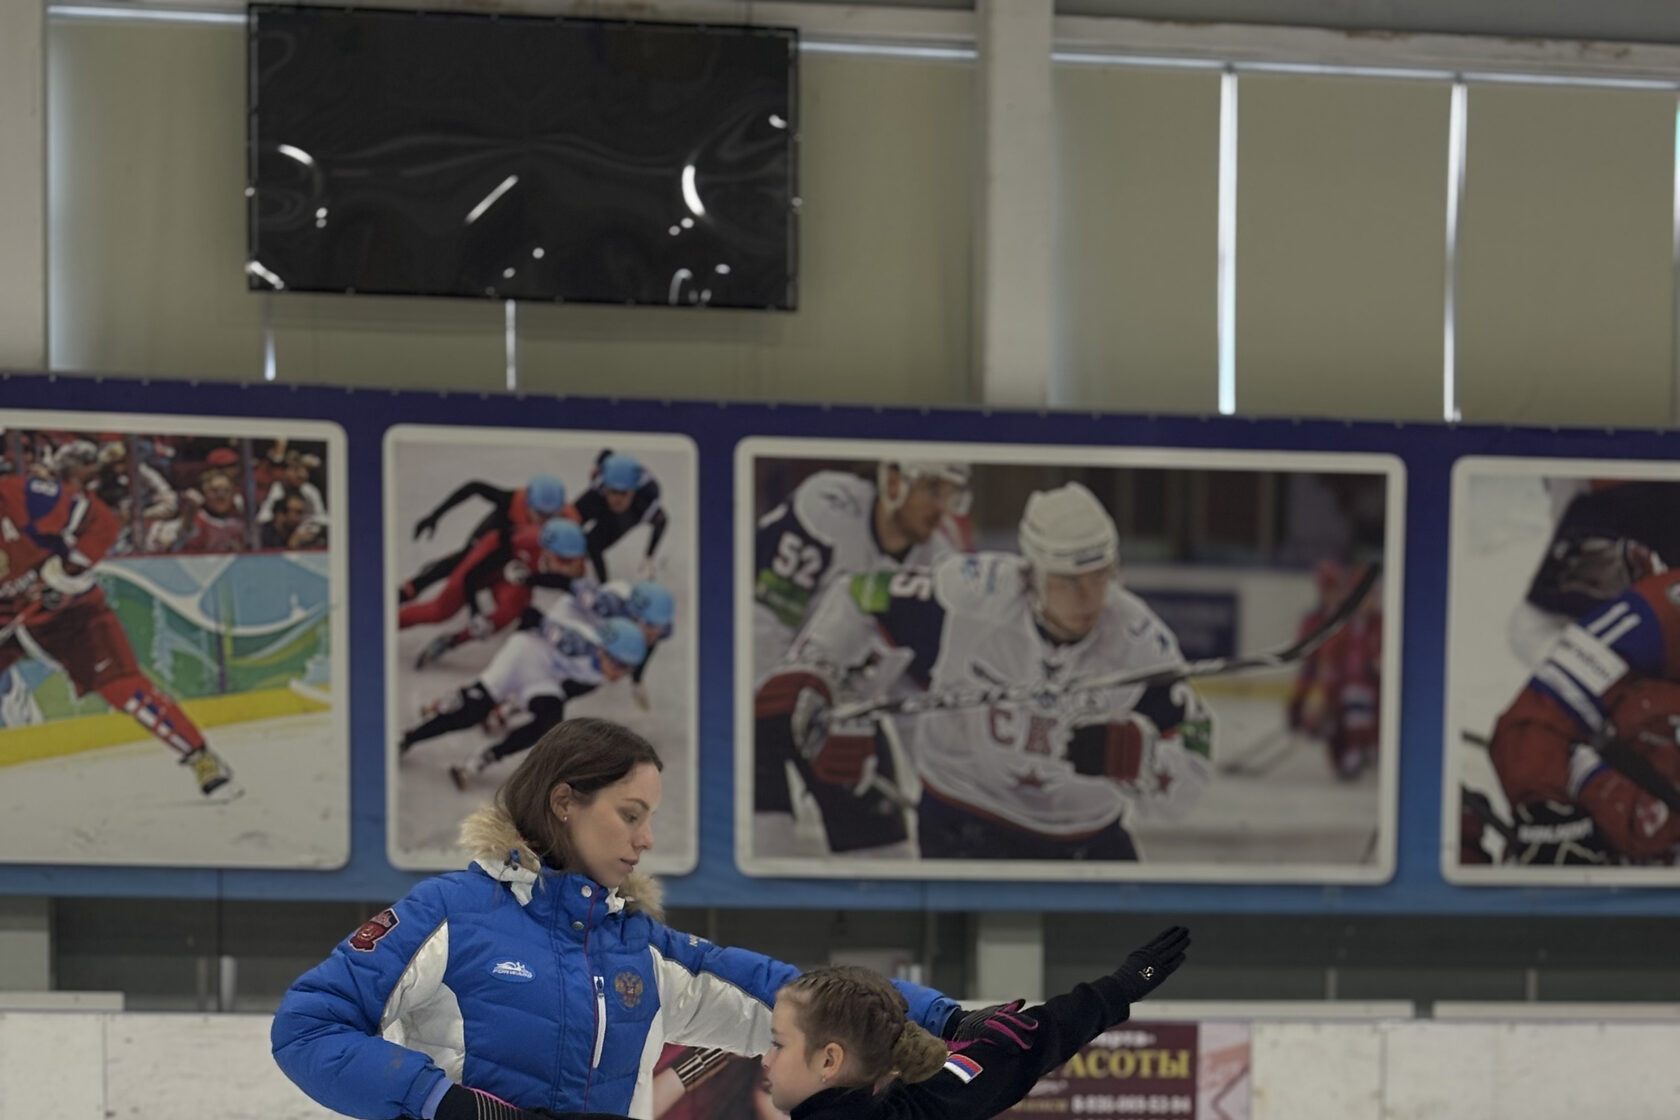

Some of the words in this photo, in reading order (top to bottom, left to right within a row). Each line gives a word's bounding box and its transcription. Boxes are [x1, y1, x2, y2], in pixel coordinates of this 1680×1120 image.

[772, 531, 823, 590] 52
[987, 704, 1058, 756] СК
[1062, 1049, 1190, 1079] АСОТЫ
